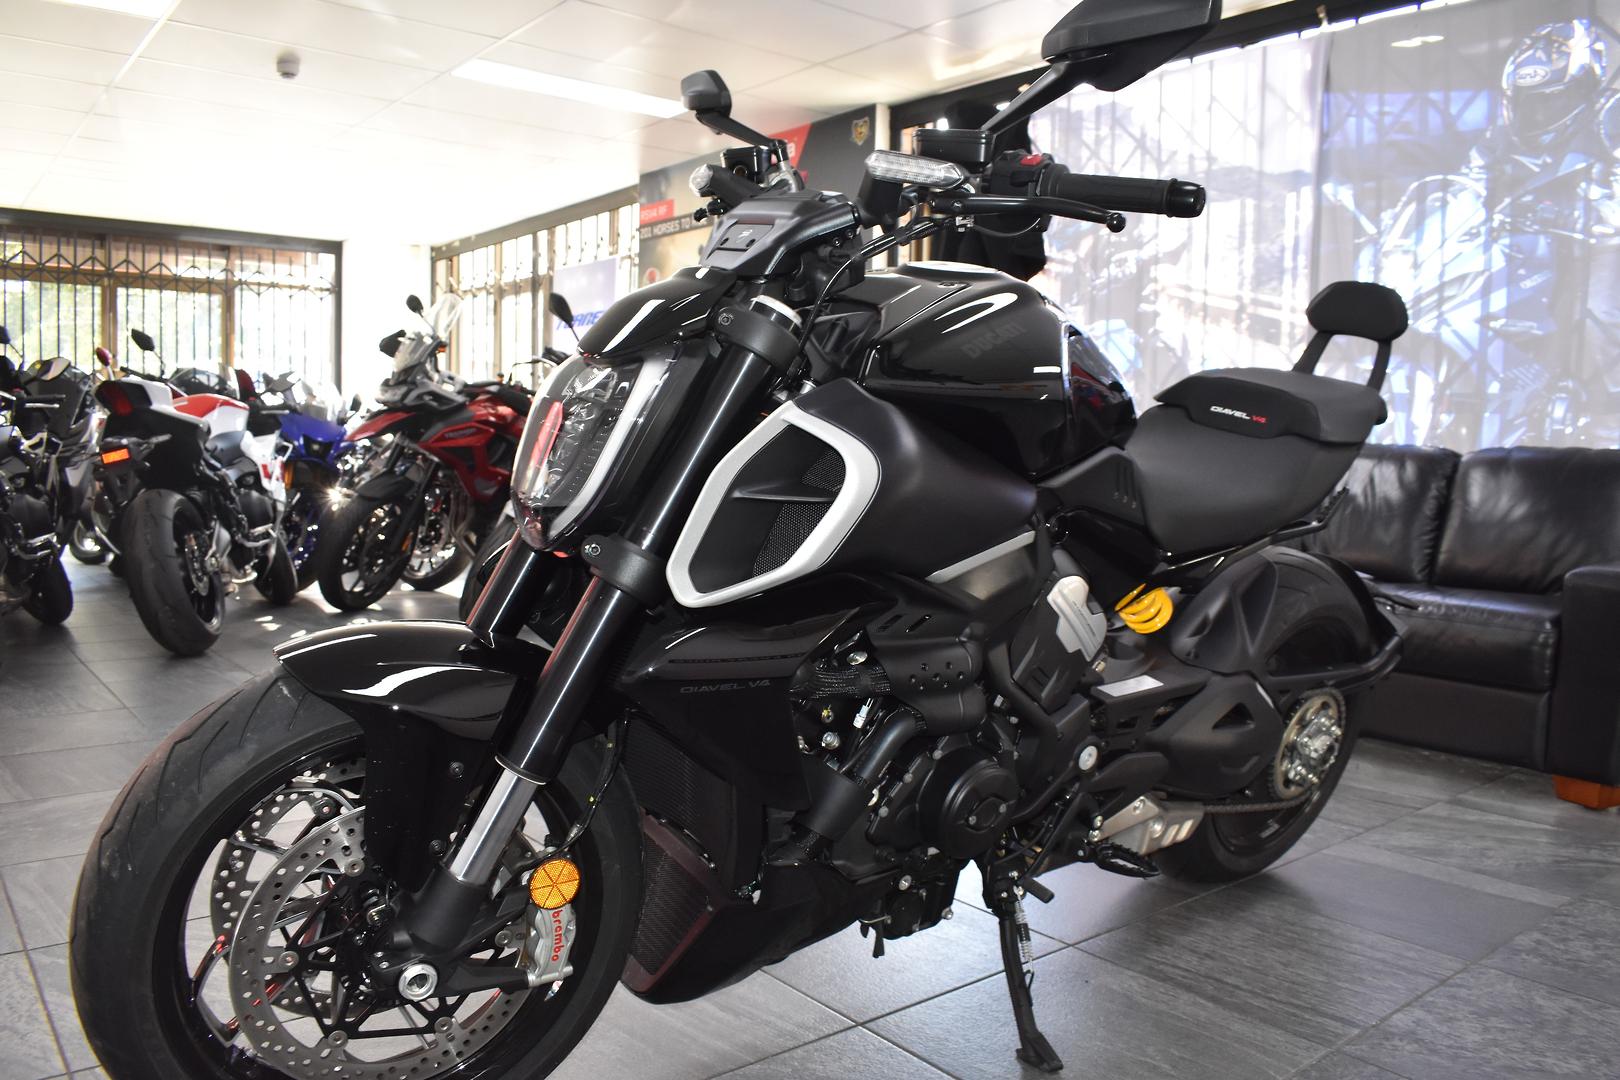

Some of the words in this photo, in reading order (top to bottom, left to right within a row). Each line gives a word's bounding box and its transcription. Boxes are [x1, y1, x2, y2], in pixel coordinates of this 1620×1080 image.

[652, 219, 680, 236] HORSES
[681, 216, 691, 229] TO
[961, 321, 1027, 358] DUCATI
[1210, 405, 1250, 420] DIAVEL
[680, 684, 745, 693] DIAVEL
[748, 679, 771, 688] V4
[551, 909, 565, 961] brembo
